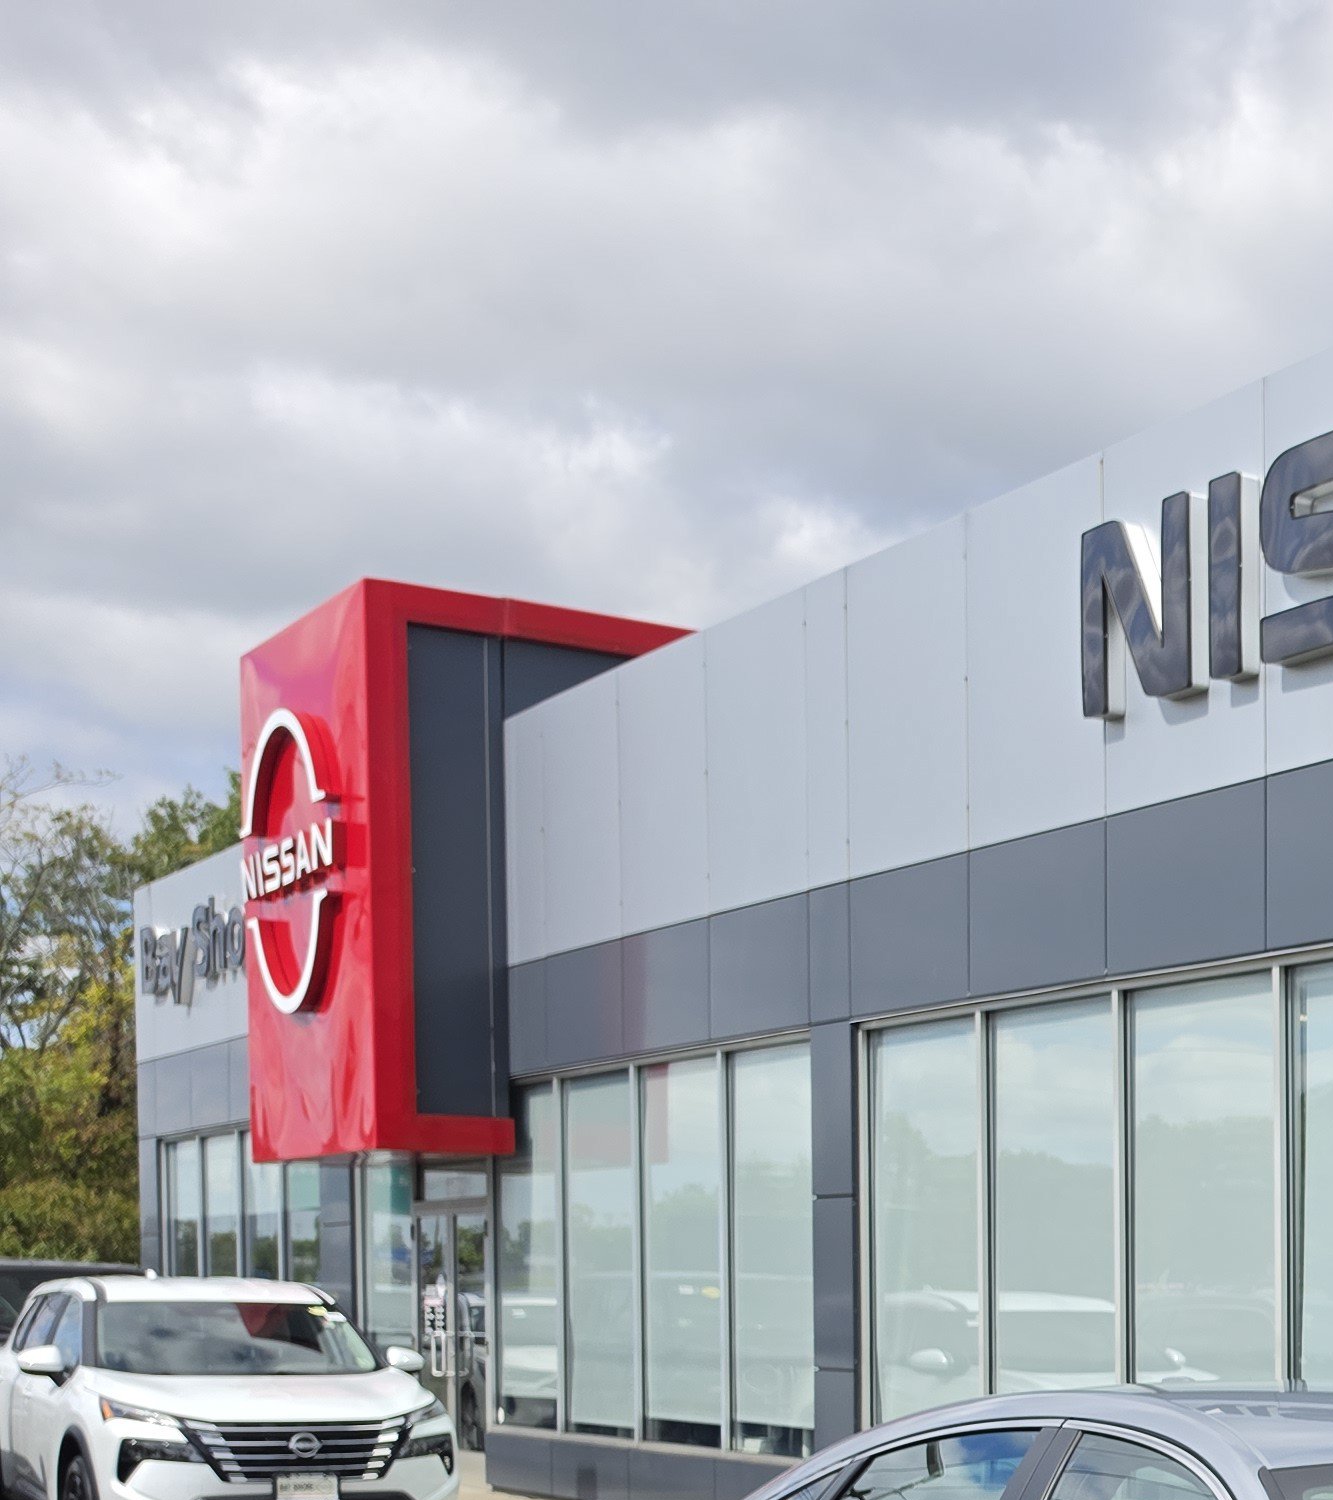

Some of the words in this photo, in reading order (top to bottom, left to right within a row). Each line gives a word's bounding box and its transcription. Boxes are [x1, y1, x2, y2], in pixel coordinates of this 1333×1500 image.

[240, 816, 333, 900] NISSAN
[139, 924, 194, 1009] Bay
[192, 894, 246, 984] Sho
